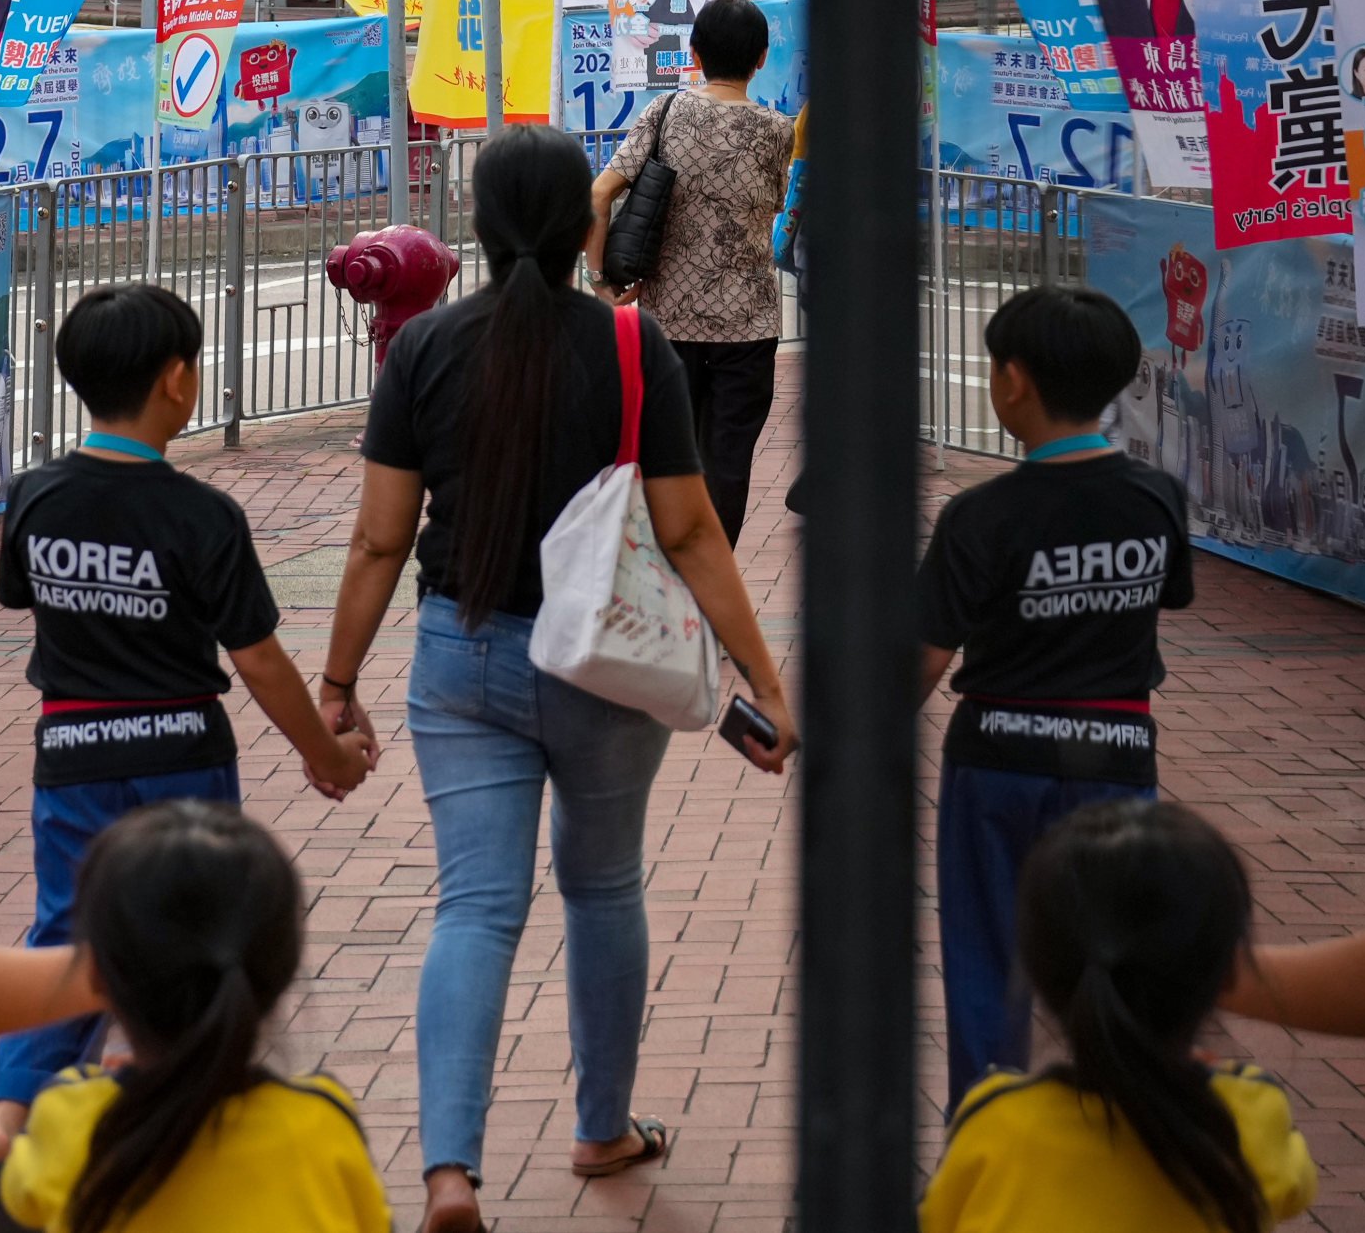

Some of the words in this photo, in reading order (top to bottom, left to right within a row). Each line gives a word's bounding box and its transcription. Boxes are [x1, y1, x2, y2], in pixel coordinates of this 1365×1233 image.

[22, 13, 72, 33] YUEN
[189, 10, 213, 24] Middle
[215, 8, 238, 20] Class
[572, 42, 585, 50] Join
[586, 41, 596, 49] the
[59, 66, 78, 75] Future
[251, 70, 280, 88] 投票箱
[27, 534, 163, 589] KOREA
[31, 580, 168, 620] TAEKWONDO
[100, 715, 152, 742] YONG
